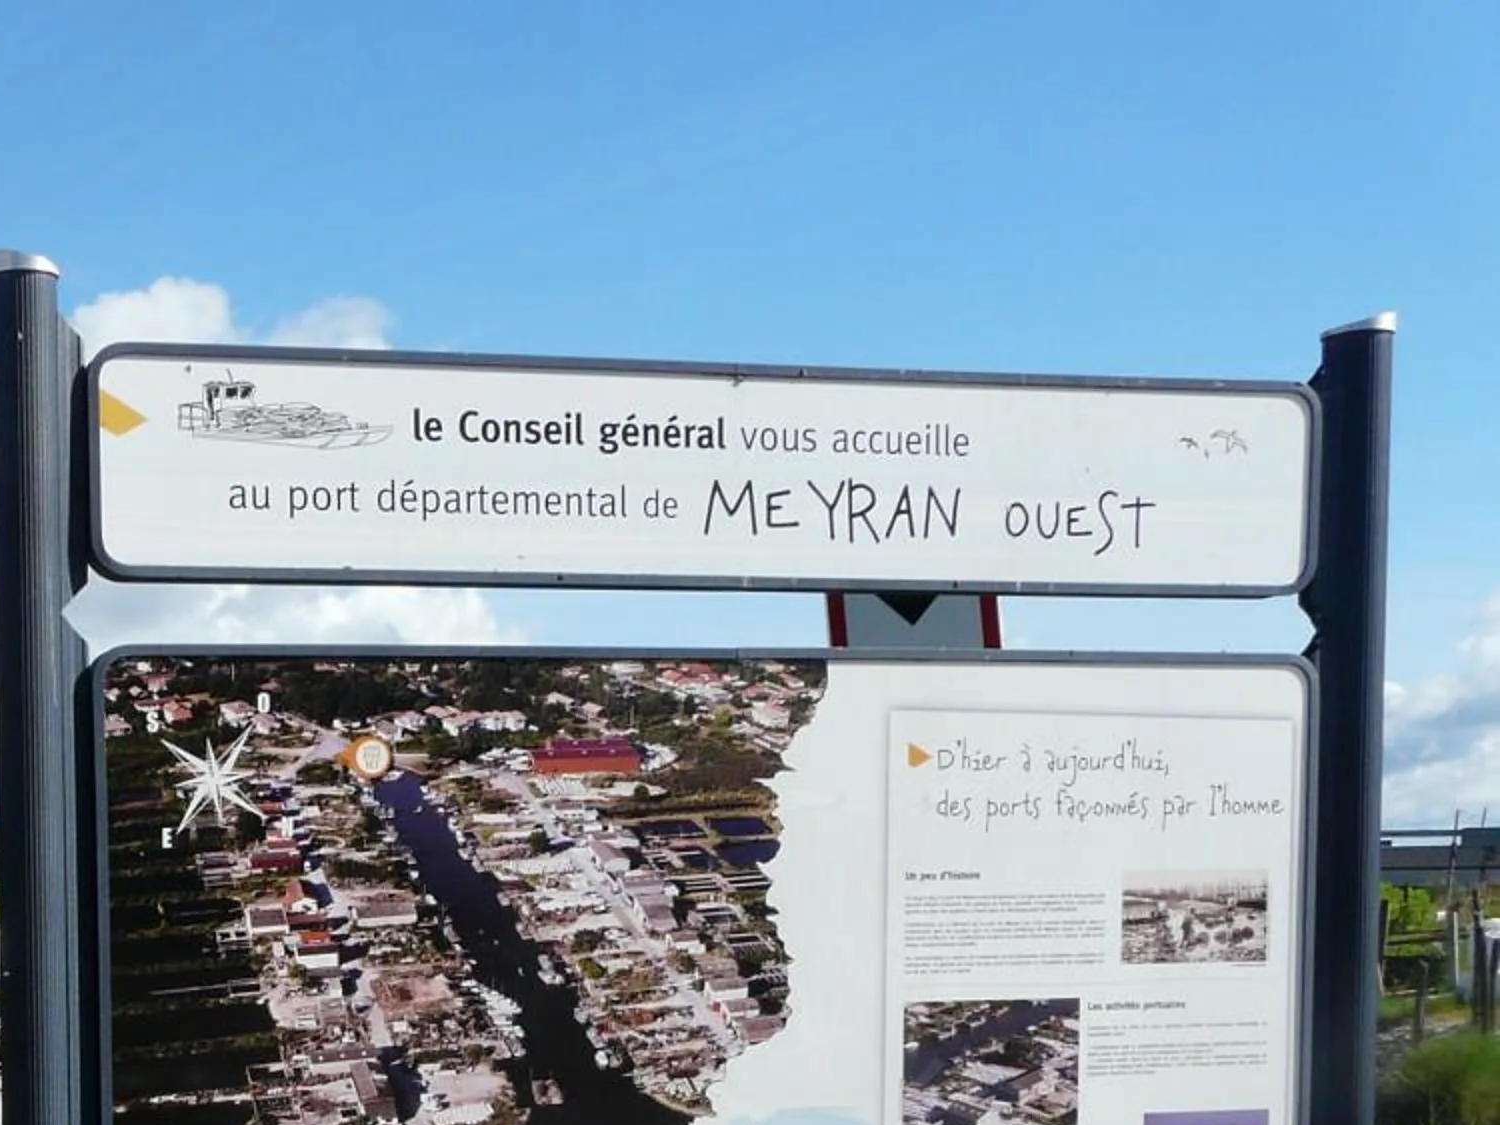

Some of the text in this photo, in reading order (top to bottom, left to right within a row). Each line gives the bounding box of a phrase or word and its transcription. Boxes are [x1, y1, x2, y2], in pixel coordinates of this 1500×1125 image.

[413, 407, 970, 457] le Conseil général vous accueille
[228, 477, 1157, 556] au port départemental de MEYRAN OUEST
[937, 736, 1169, 788] D'hier à aujourd'hui,
[936, 782, 1285, 833] des ports façonnés par l'homme
[161, 827, 173, 849] E
